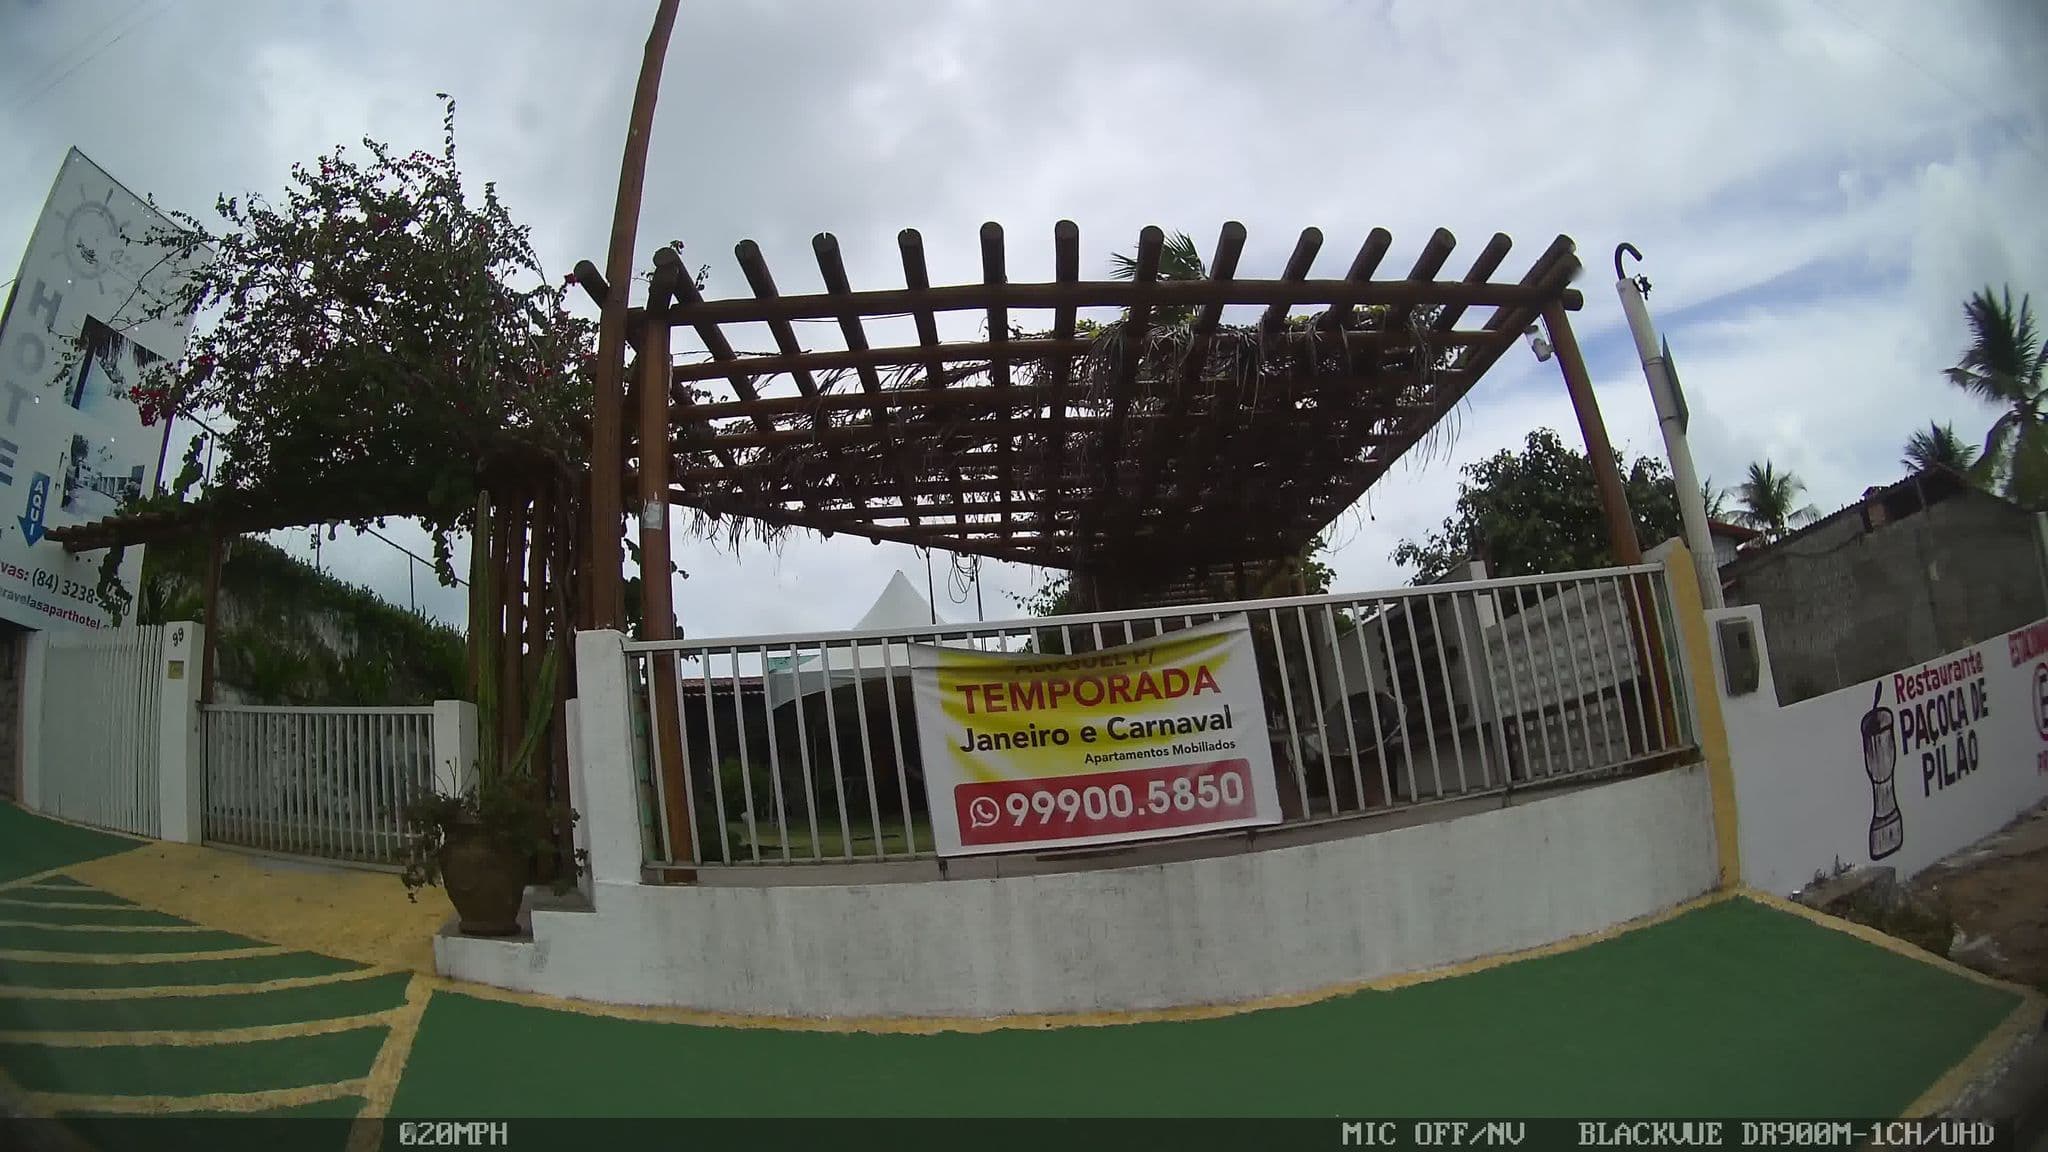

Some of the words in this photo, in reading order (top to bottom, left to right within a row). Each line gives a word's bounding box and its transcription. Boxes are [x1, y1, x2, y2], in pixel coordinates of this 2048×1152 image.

[0, 277, 63, 538] HOTE
[29, 479, 44, 536] AQUI
[32, 567, 59, 594] (84)
[62, 580, 133, 616] 3238-0
[956, 665, 1221, 714] TEMPORADA
[1894, 651, 1984, 704] Restaurante
[1970, 677, 1989, 722] DE
[960, 723, 1070, 753] Janeiro
[1081, 726, 1097, 744] e
[1107, 705, 1234, 742] Carnaval
[1084, 747, 1170, 765] Apartamentos
[1172, 738, 1236, 755] Mobiliados
[1921, 729, 1979, 797] PILÃO
[1006, 771, 1244, 827] 99900.5850
